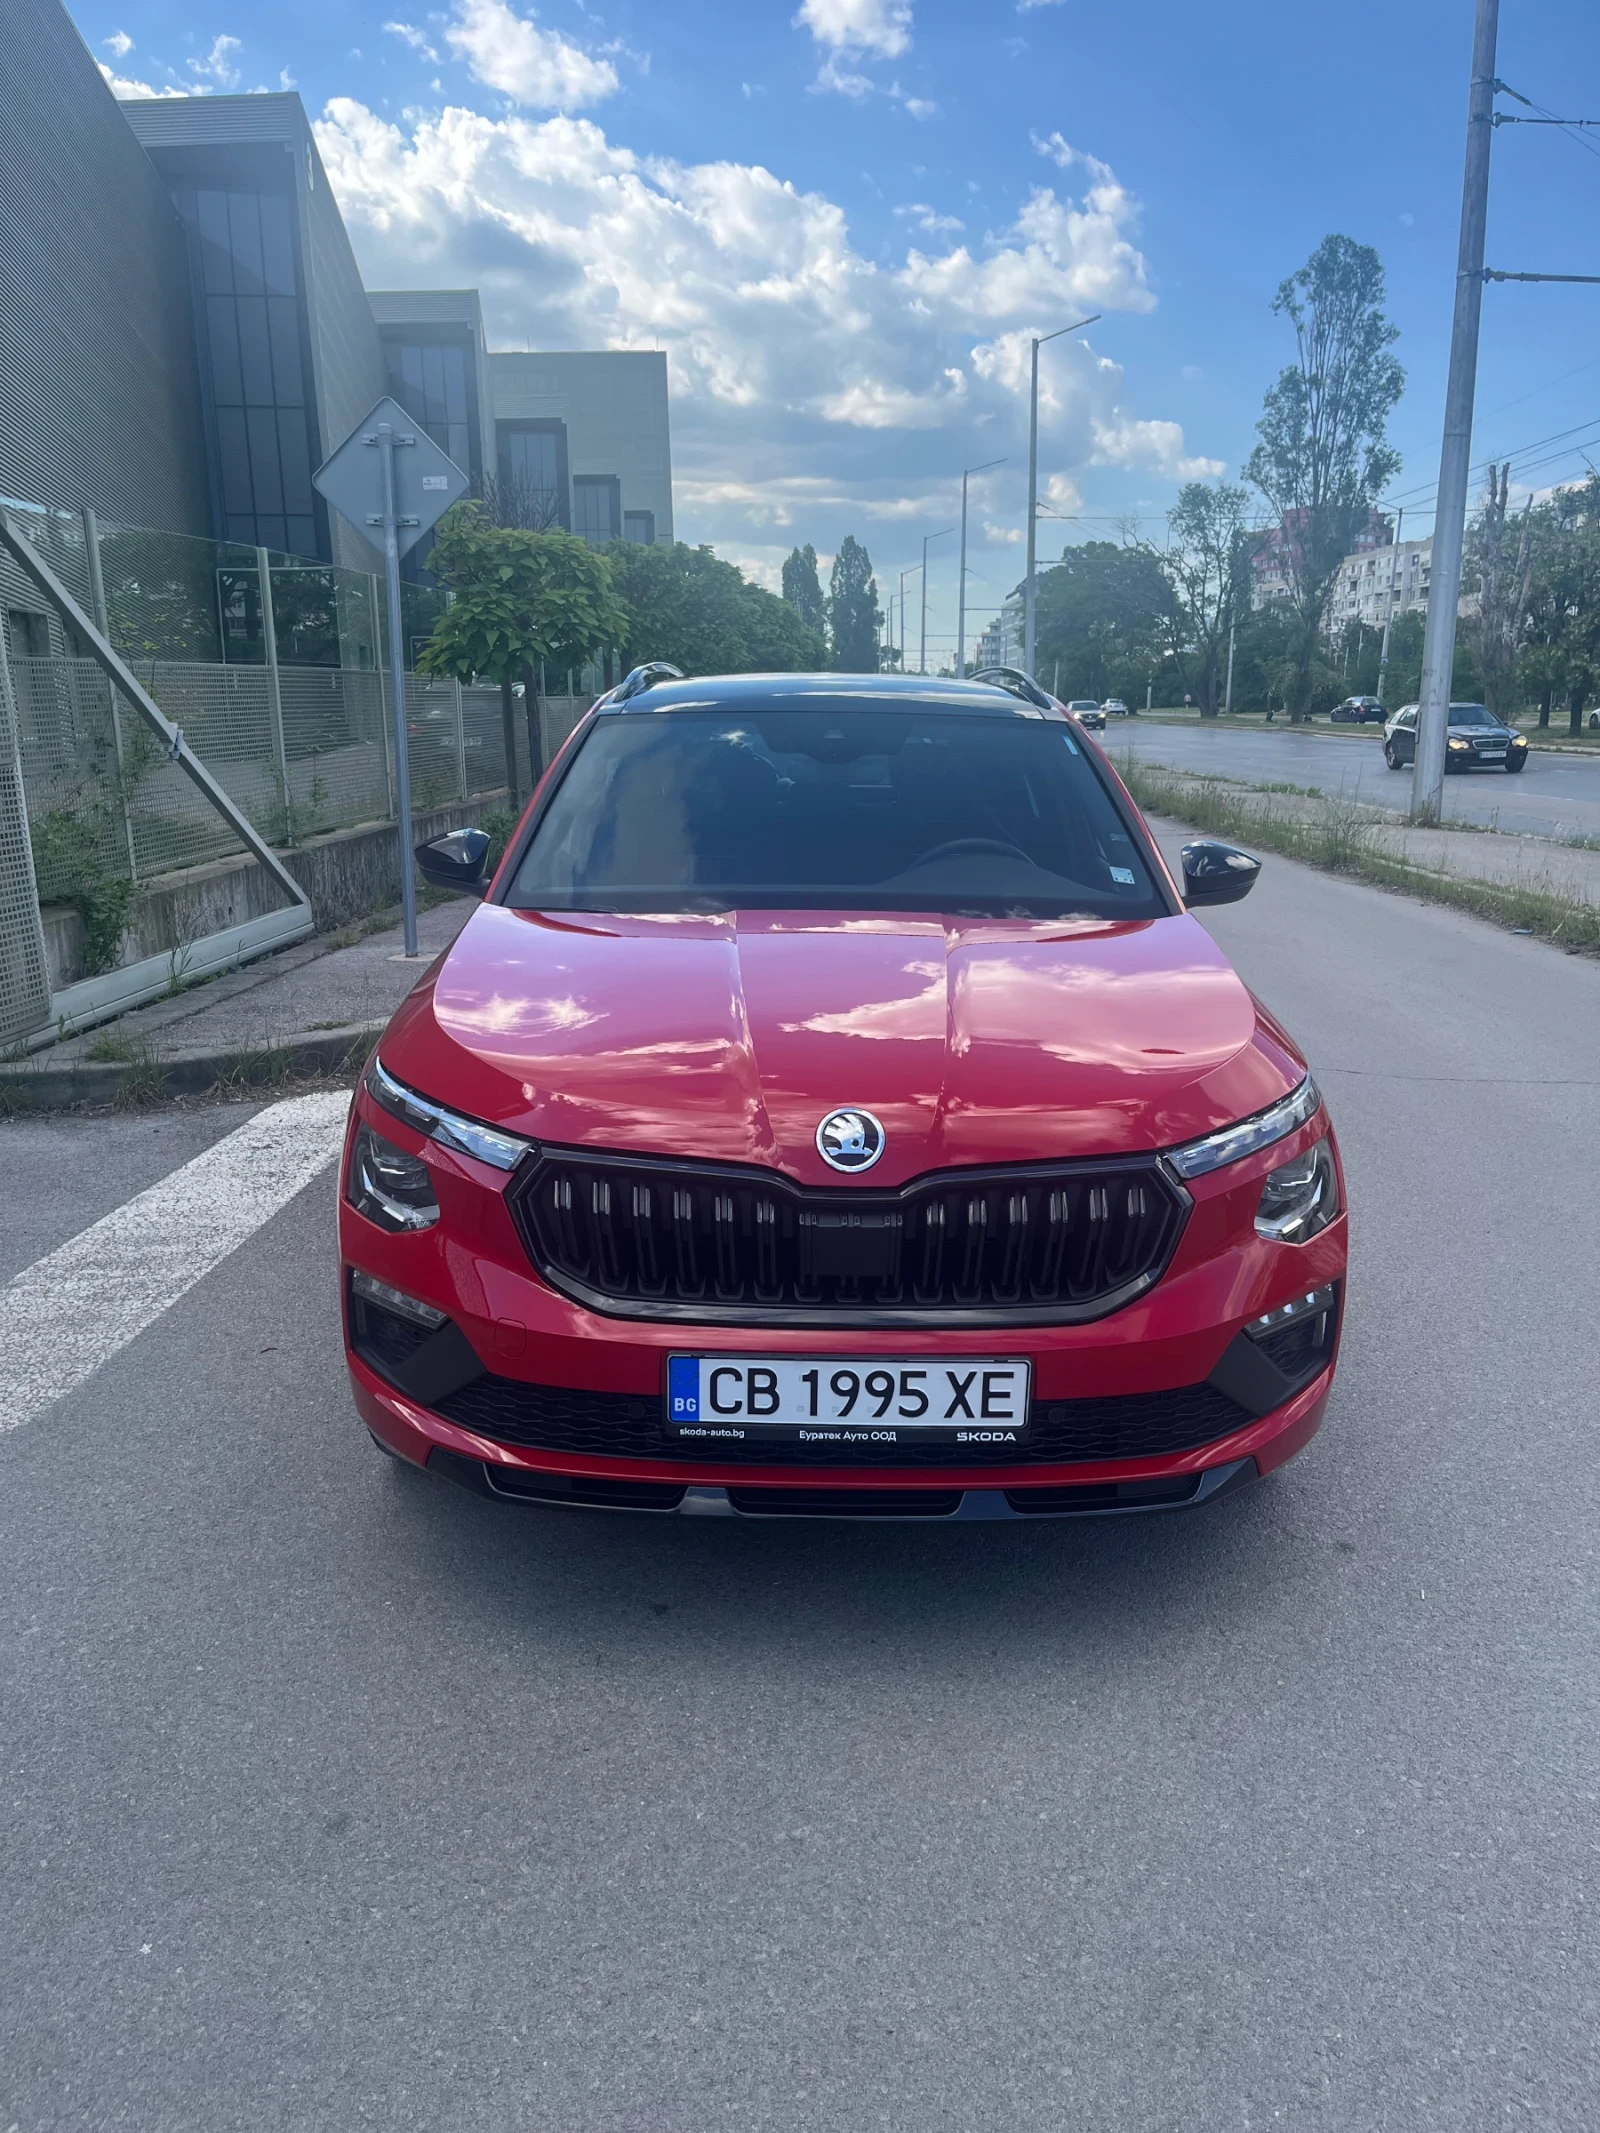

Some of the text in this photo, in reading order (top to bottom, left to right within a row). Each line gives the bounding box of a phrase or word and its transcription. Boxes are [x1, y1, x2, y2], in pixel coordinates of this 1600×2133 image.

[709, 1367, 1014, 1419] CB 1995 XE
[674, 1398, 697, 1412] BG
[679, 1427, 745, 1439] skoda-auto.bg
[799, 1430, 897, 1442] Еуратек Ауто ООД
